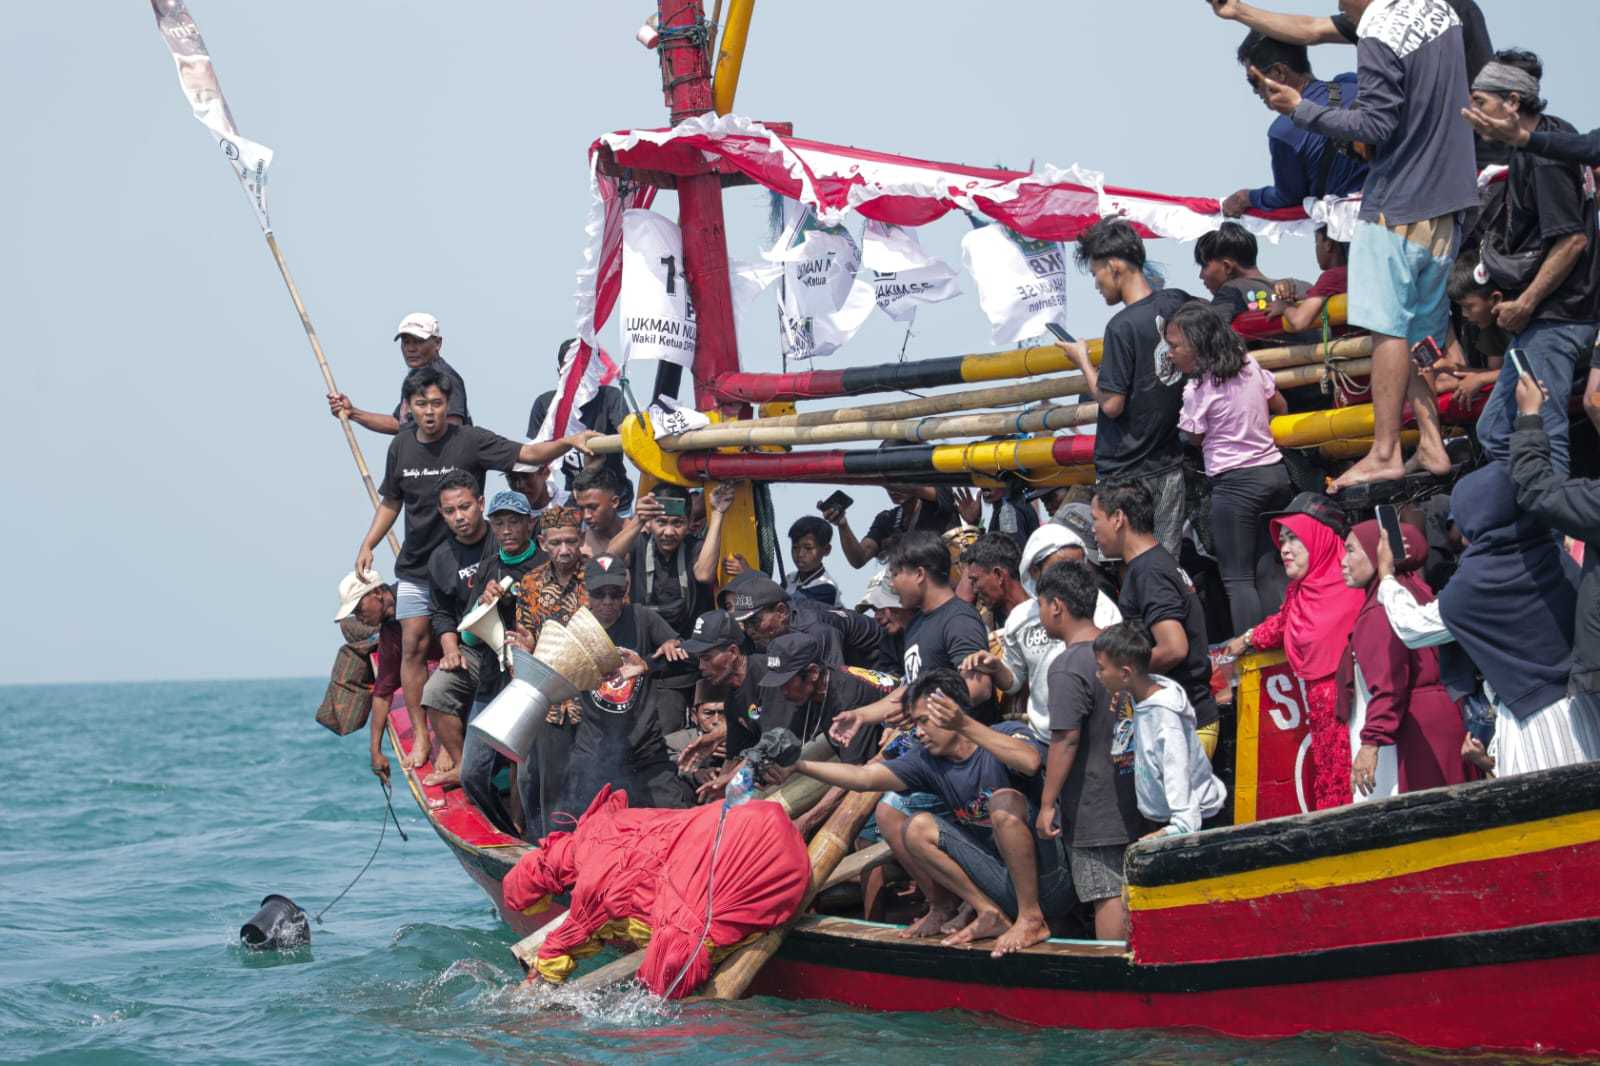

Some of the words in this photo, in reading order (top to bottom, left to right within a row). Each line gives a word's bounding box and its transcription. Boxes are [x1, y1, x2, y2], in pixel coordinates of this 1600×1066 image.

[626, 317, 680, 335] LUKMAN
[632, 333, 656, 345] Wakil
[659, 336, 683, 350] Ketua
